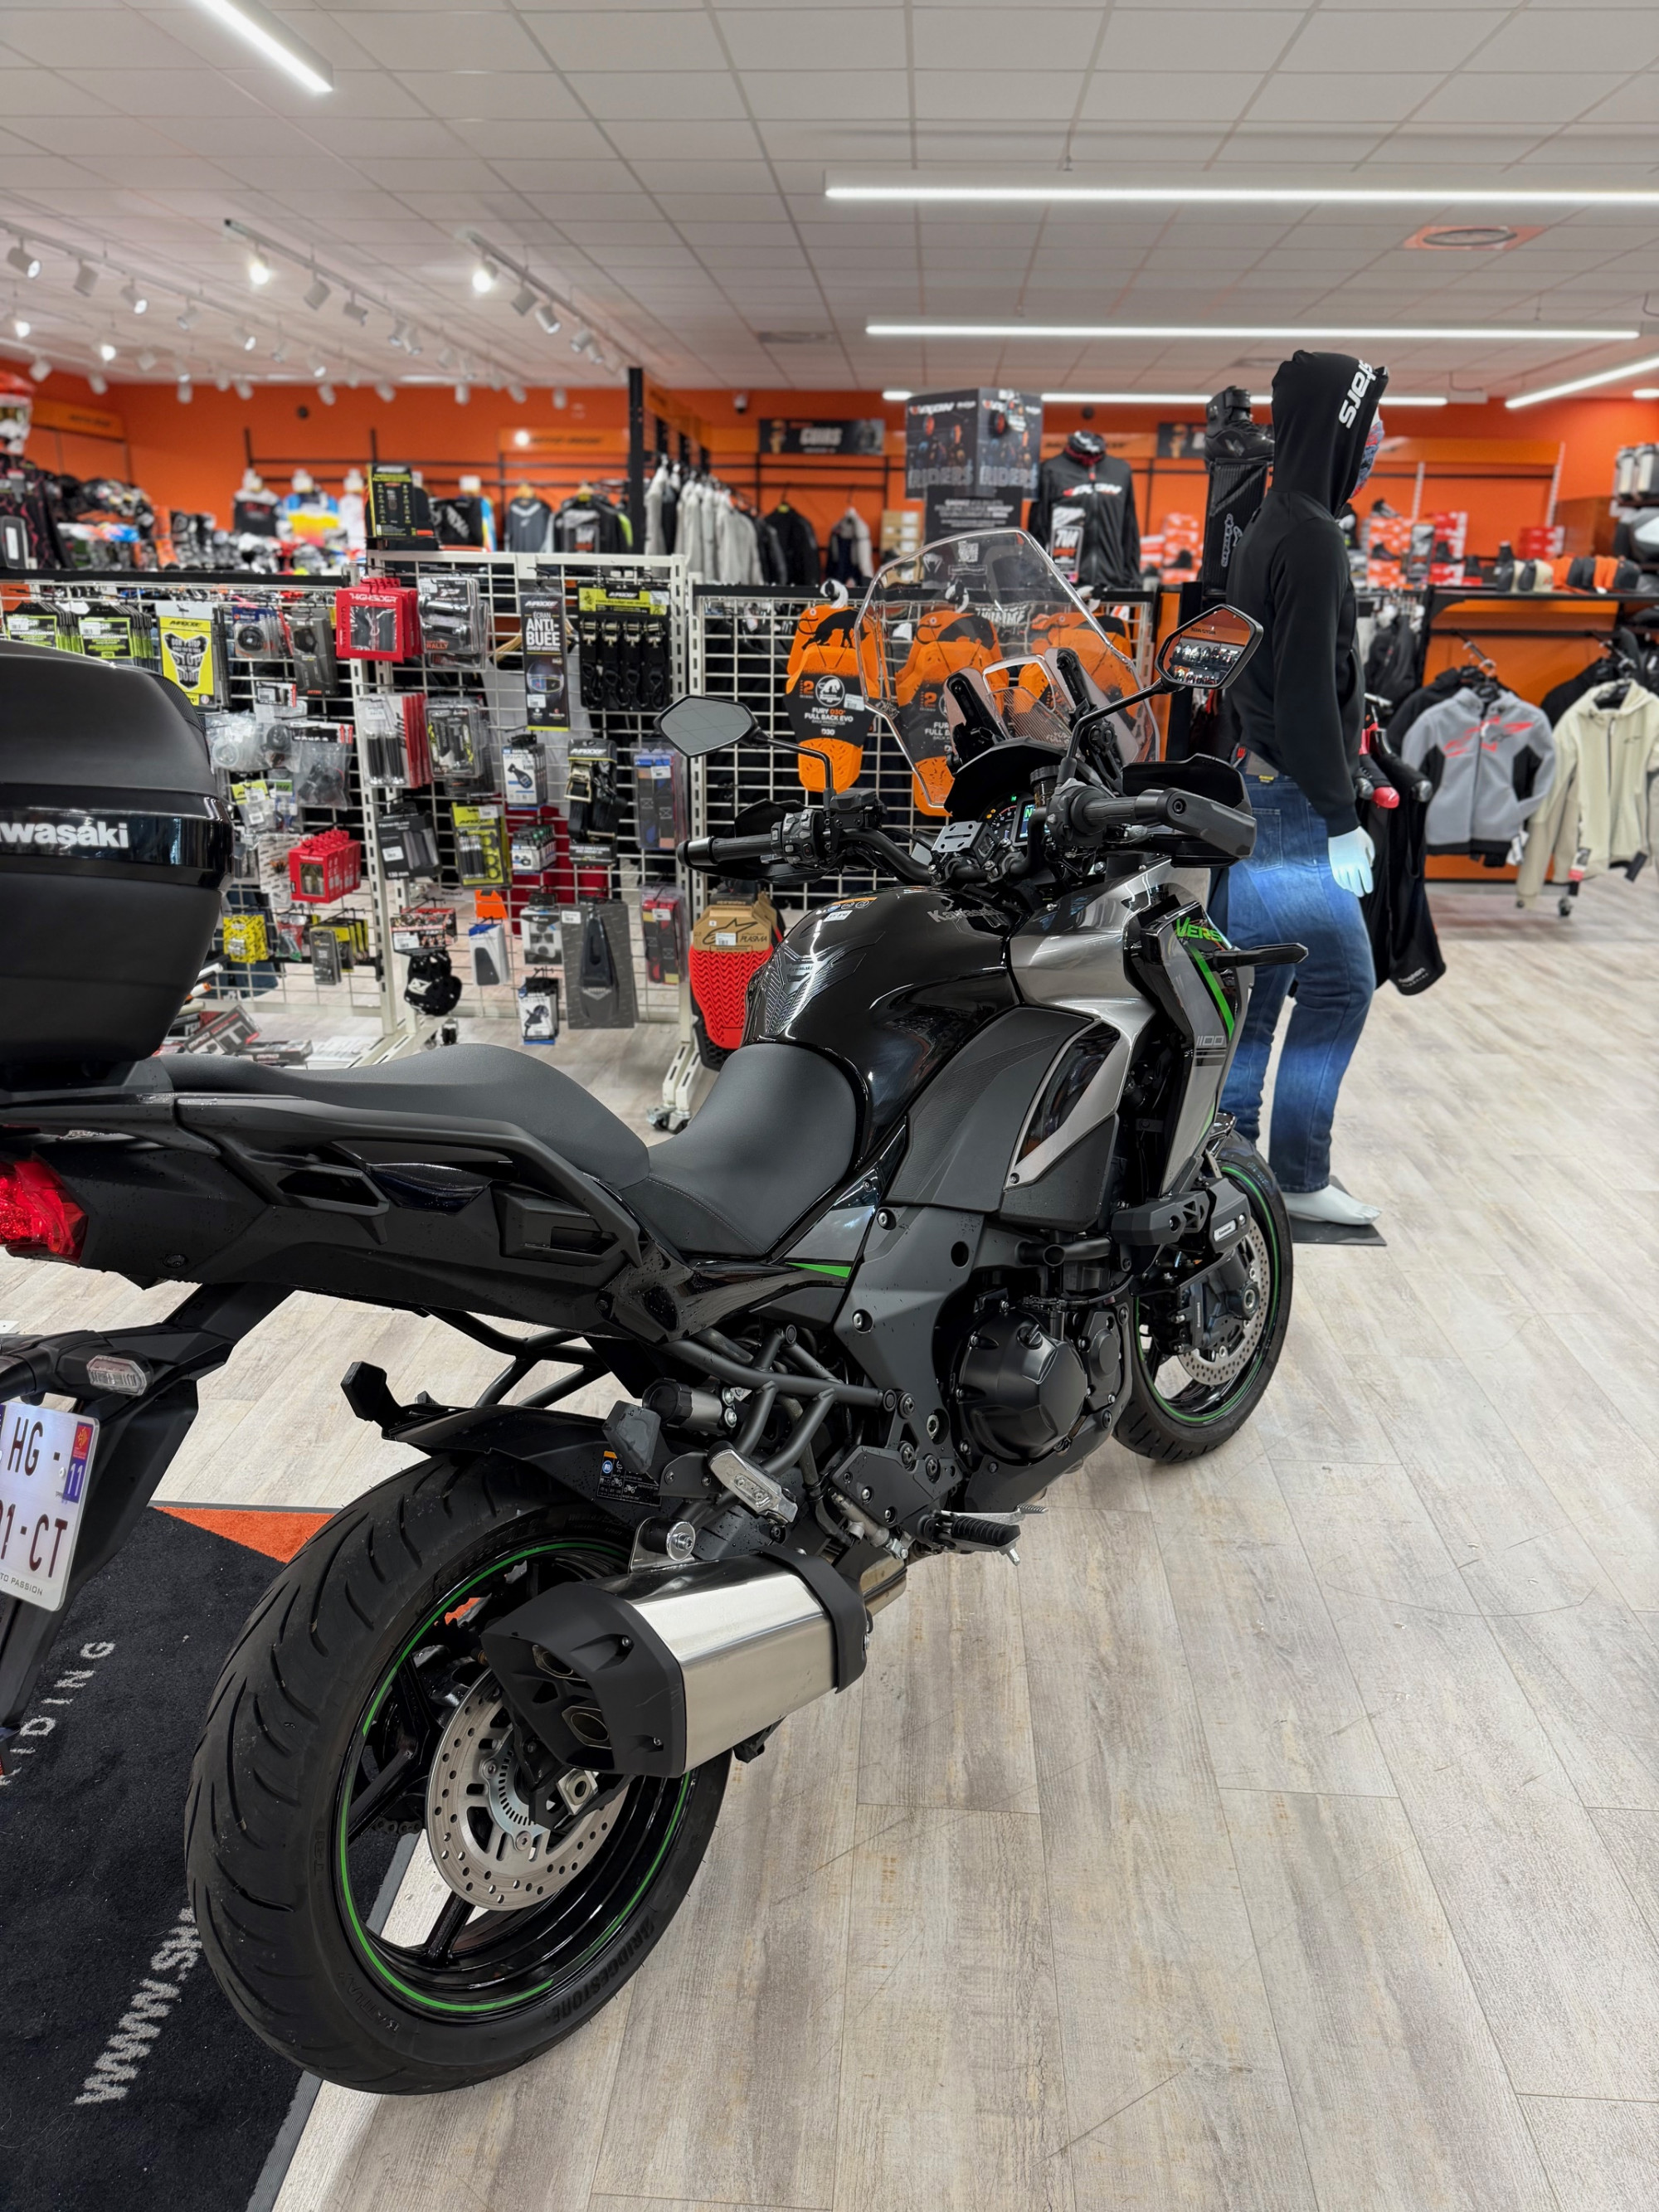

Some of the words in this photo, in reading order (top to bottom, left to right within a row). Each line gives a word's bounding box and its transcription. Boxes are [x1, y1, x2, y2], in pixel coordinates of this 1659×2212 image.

[803, 680, 814, 694] 2
[924, 727, 944, 736] FULL
[0, 820, 129, 848] wasaki
[67, 1462, 84, 1497] 11
[10, 1578, 43, 1596] PASSION
[550, 1916, 655, 2025] BRIDGESTONE
